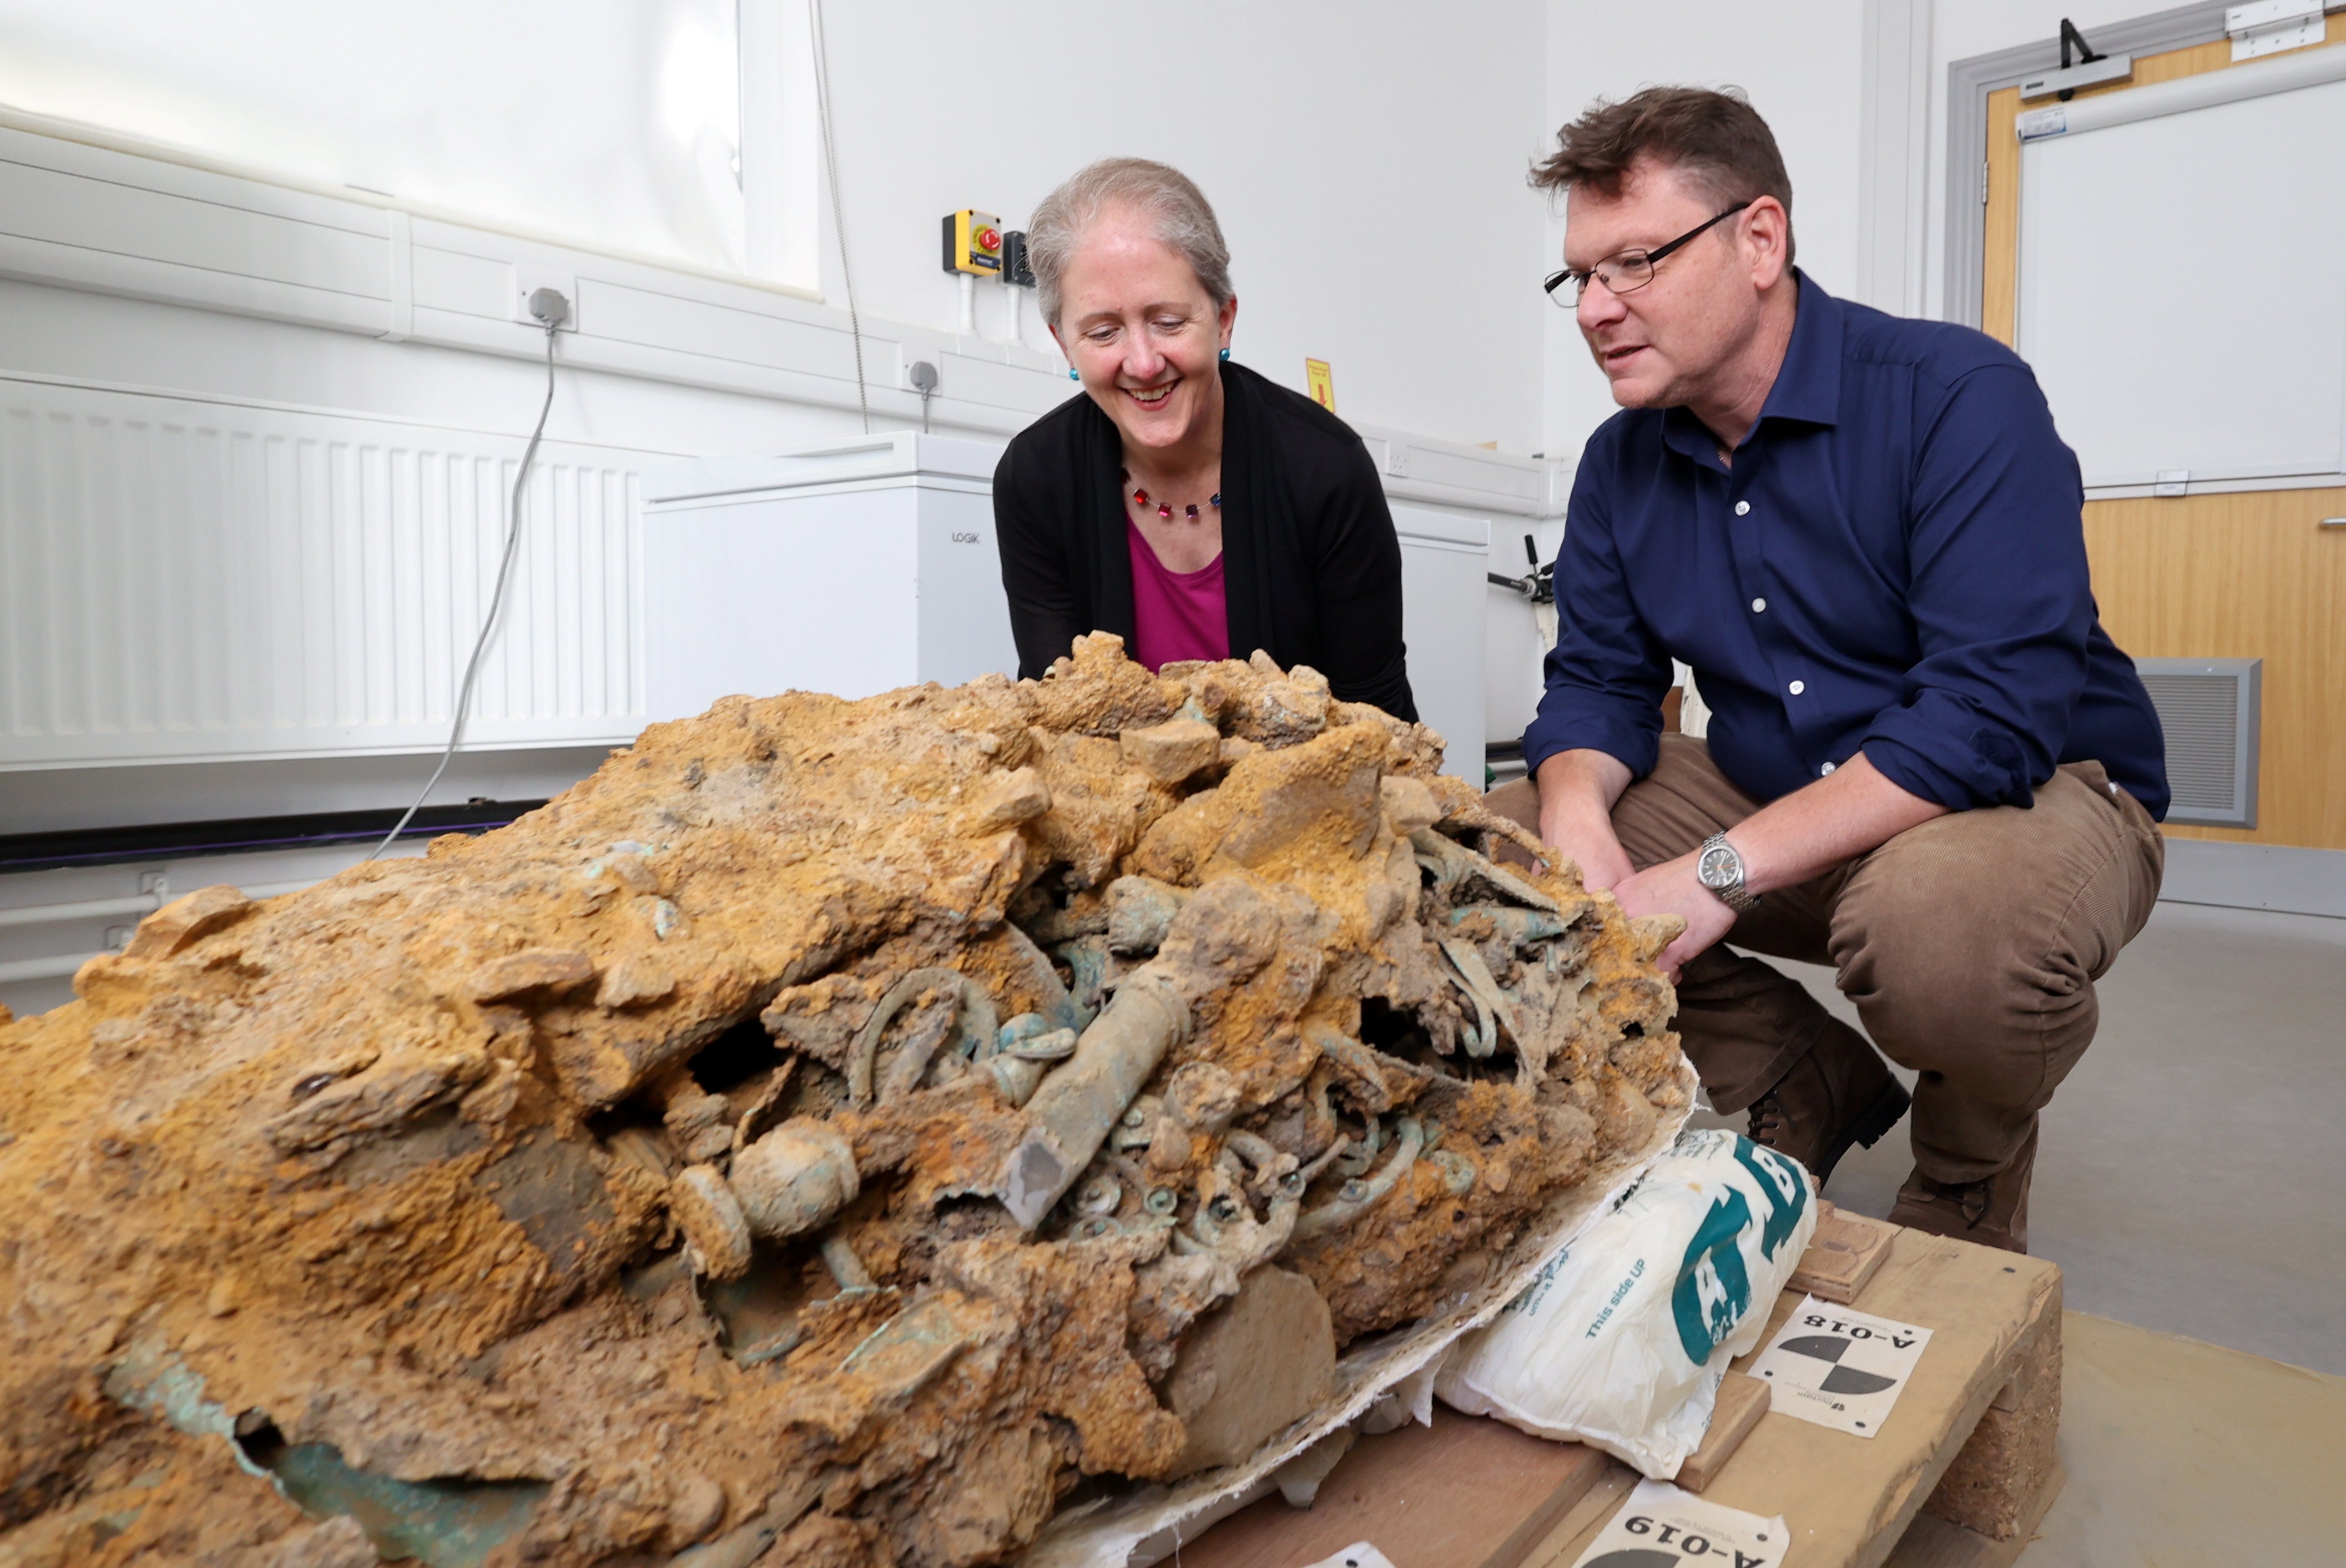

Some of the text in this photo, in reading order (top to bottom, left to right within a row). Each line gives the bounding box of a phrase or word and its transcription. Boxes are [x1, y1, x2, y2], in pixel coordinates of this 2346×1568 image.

[952, 532, 980, 544] LOGIK
[1585, 1258, 1646, 1339] This side UP
[1804, 1315, 1916, 1349] A-018
[1625, 1516, 1765, 1568] A-019
